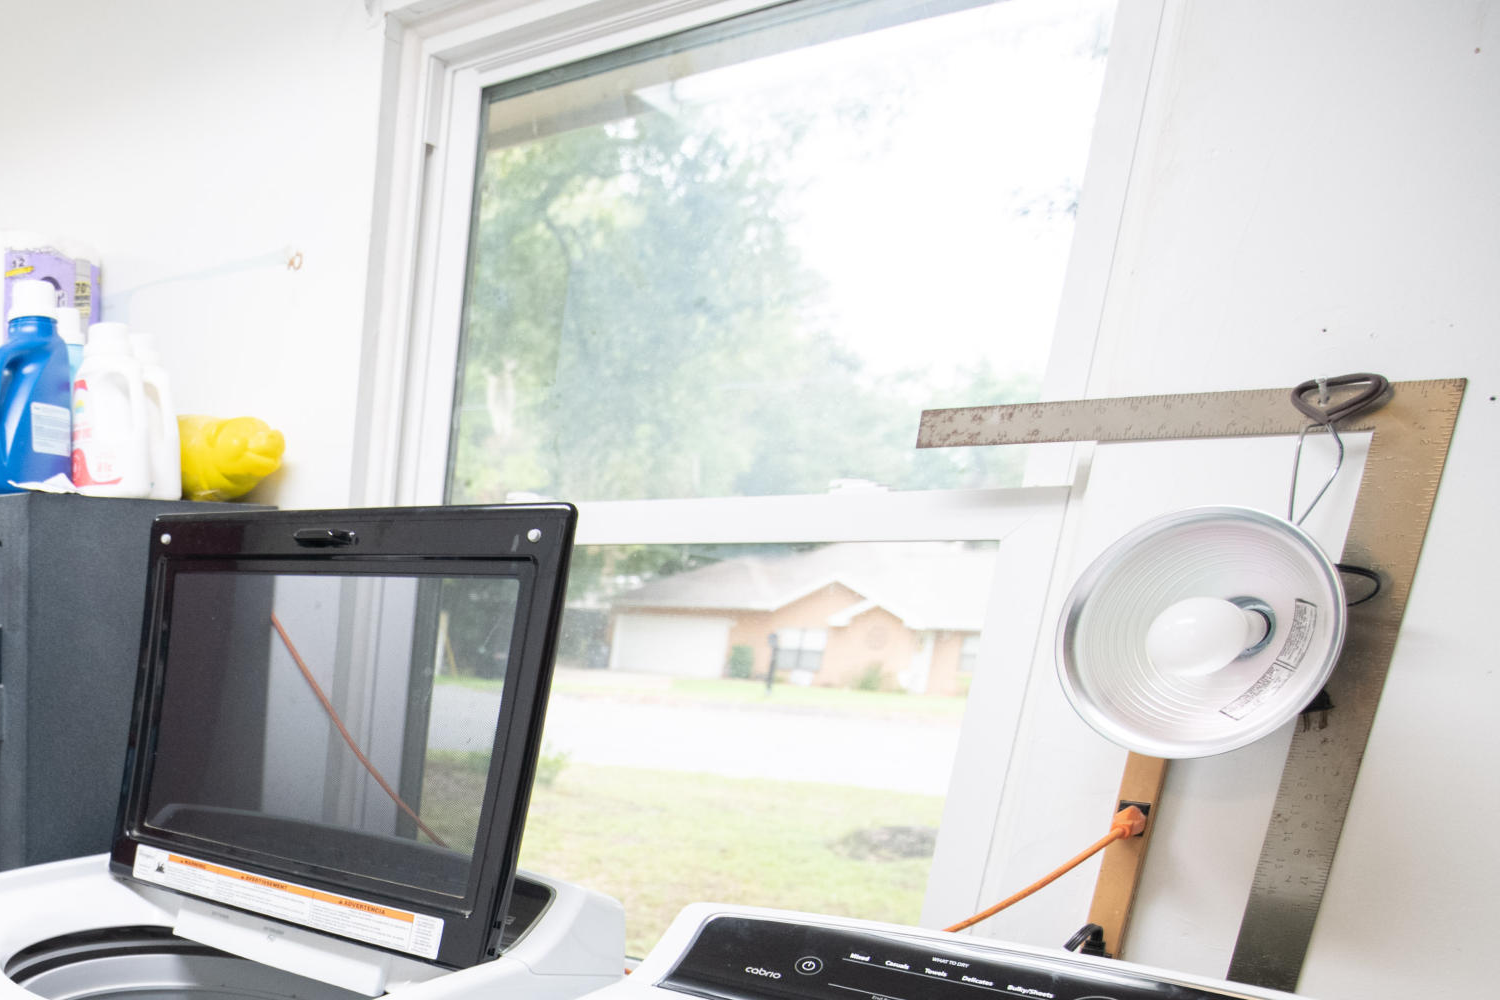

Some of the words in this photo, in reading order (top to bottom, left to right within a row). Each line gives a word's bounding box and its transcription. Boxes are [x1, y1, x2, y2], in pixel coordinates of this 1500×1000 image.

[344, 900, 386, 915] ADVERTENCIA
[949, 958, 957, 966] TO
[957, 960, 970, 968] DRY
[745, 966, 782, 980] cabrio
[924, 967, 948, 978] Towels
[961, 975, 994, 987] Delicates
[1006, 984, 1055, 999] Bulky/Sheets
